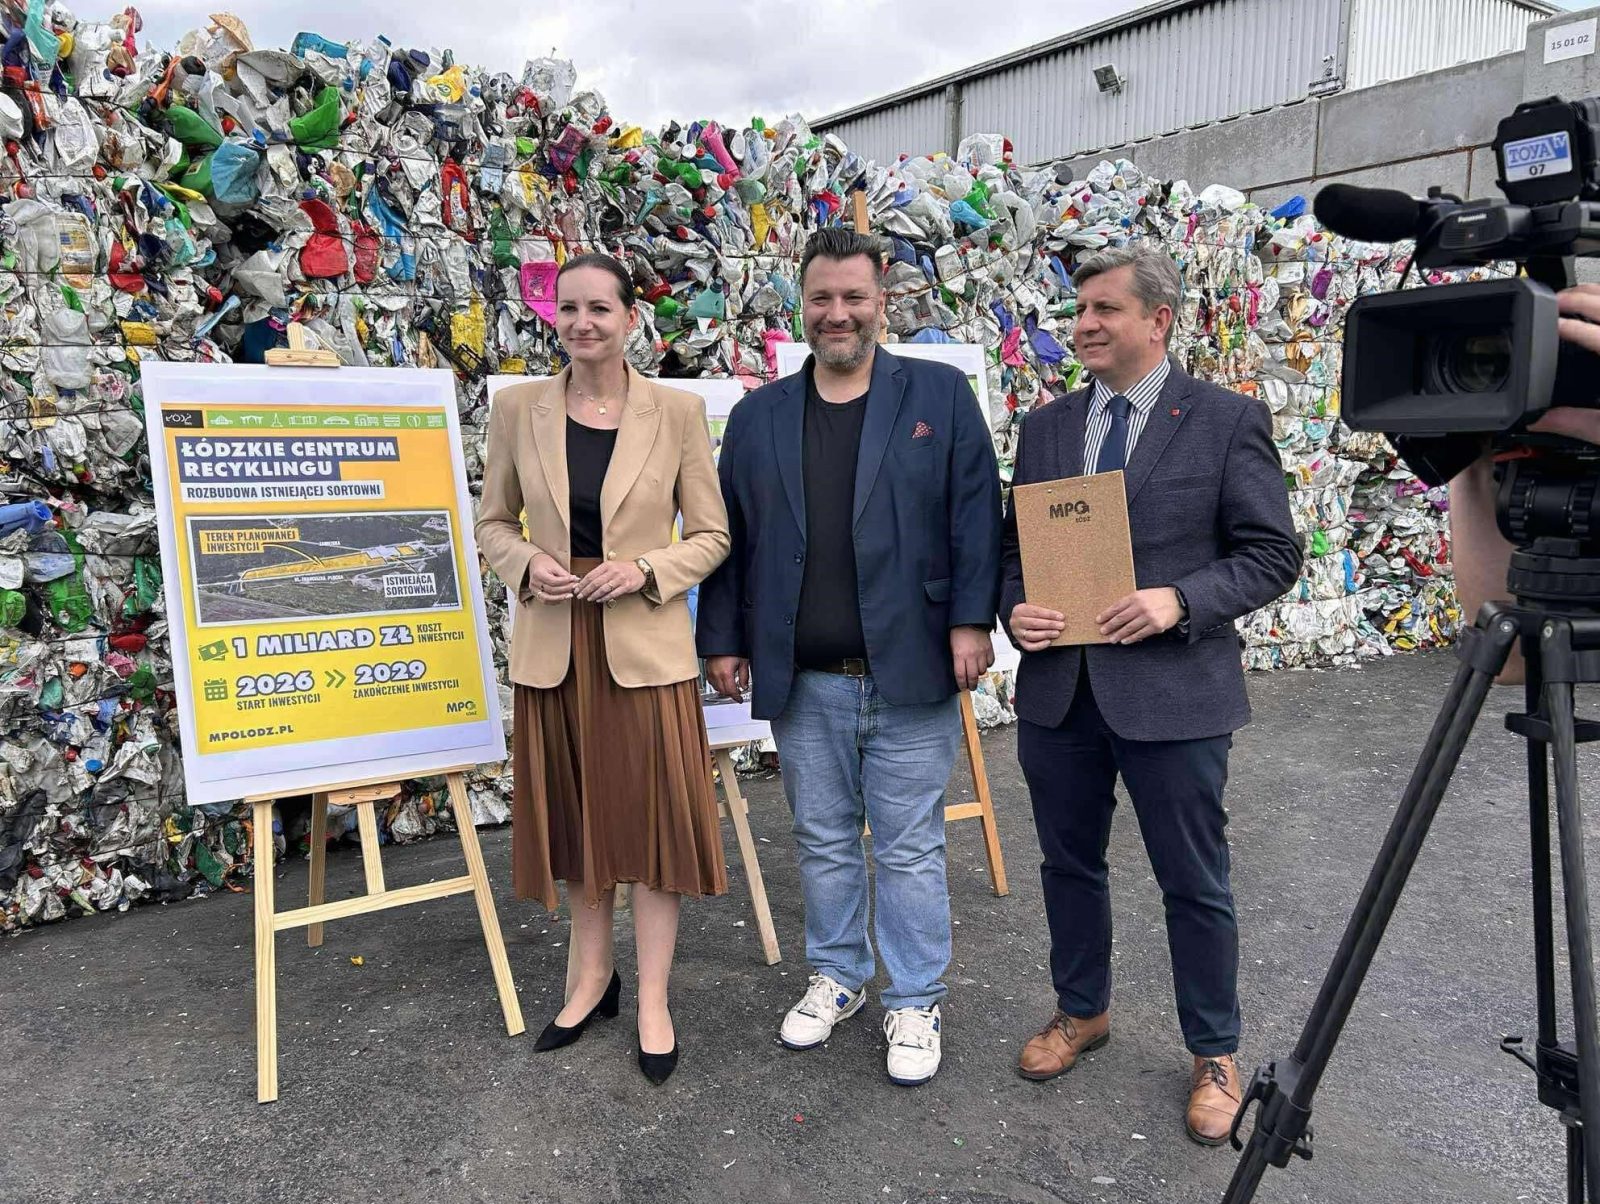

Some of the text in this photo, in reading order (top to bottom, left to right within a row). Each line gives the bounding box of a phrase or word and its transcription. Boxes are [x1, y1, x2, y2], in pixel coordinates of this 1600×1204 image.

[1551, 35, 1589, 50] 15 01 02
[1509, 142, 1551, 163] TOYA
[1529, 164, 1545, 176] 07
[181, 438, 396, 457] ŁÓDZKIE CENTRUM
[184, 461, 333, 477] RECYKLINGU
[187, 484, 381, 500] ROZBUDOWA ISTNIEJĄCEJ SORTOWNI
[206, 530, 296, 541] TEREN PLANOWANEJ
[207, 542, 260, 552] INWESTYCJI
[386, 585, 435, 596] SORTOWNIA
[417, 623, 442, 633] KOSZT
[232, 625, 414, 658] 1 MILIARD ZŁ
[418, 631, 464, 643] INWESTYCJI
[236, 659, 426, 697] 2026 2029
[353, 679, 459, 698] ZAKOŃCZENIE INWESTYCJI
[237, 693, 321, 710] START INWESTYCJI
[209, 725, 294, 742] MPOLODZ.PL
